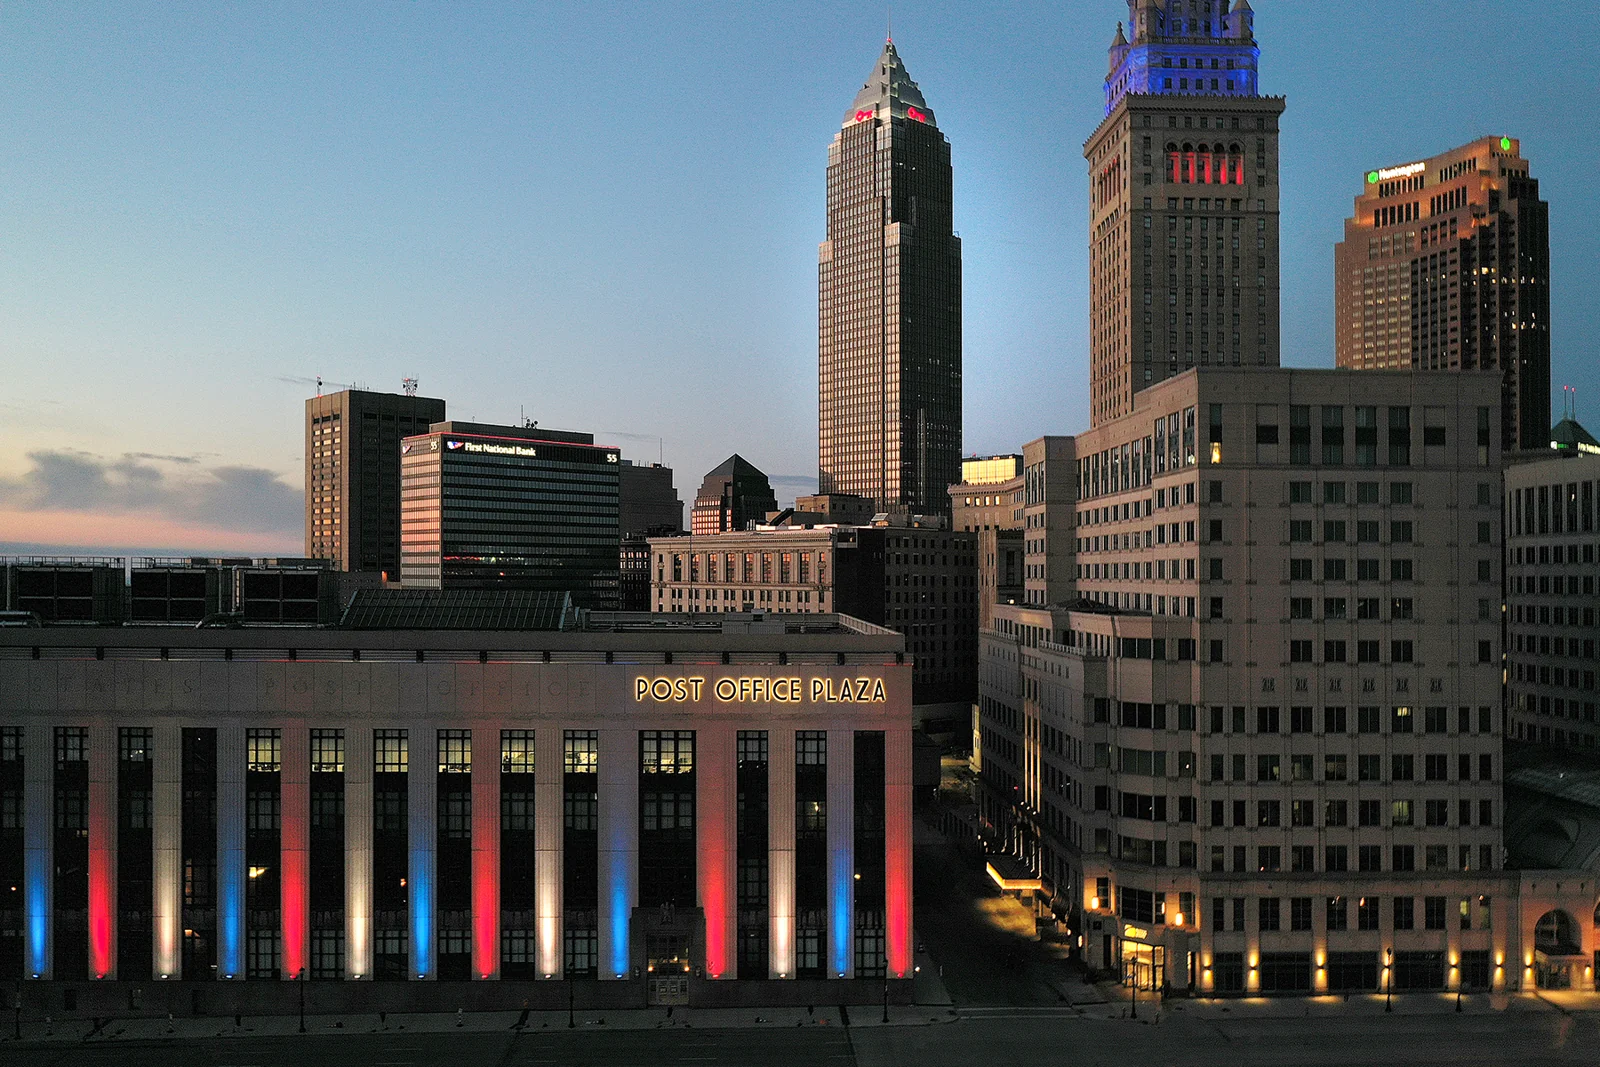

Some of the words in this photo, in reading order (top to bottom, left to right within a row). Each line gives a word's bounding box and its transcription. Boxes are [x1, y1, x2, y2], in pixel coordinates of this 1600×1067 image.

[464, 442, 482, 452] First
[483, 443, 516, 455] National
[516, 446, 536, 456] Bank
[32, 677, 194, 695] STATES
[263, 679, 368, 696] POST
[437, 680, 590, 697] OFFICE
[636, 677, 705, 701] POST
[715, 678, 802, 702] OFFICE
[811, 678, 887, 702] PLAZA
